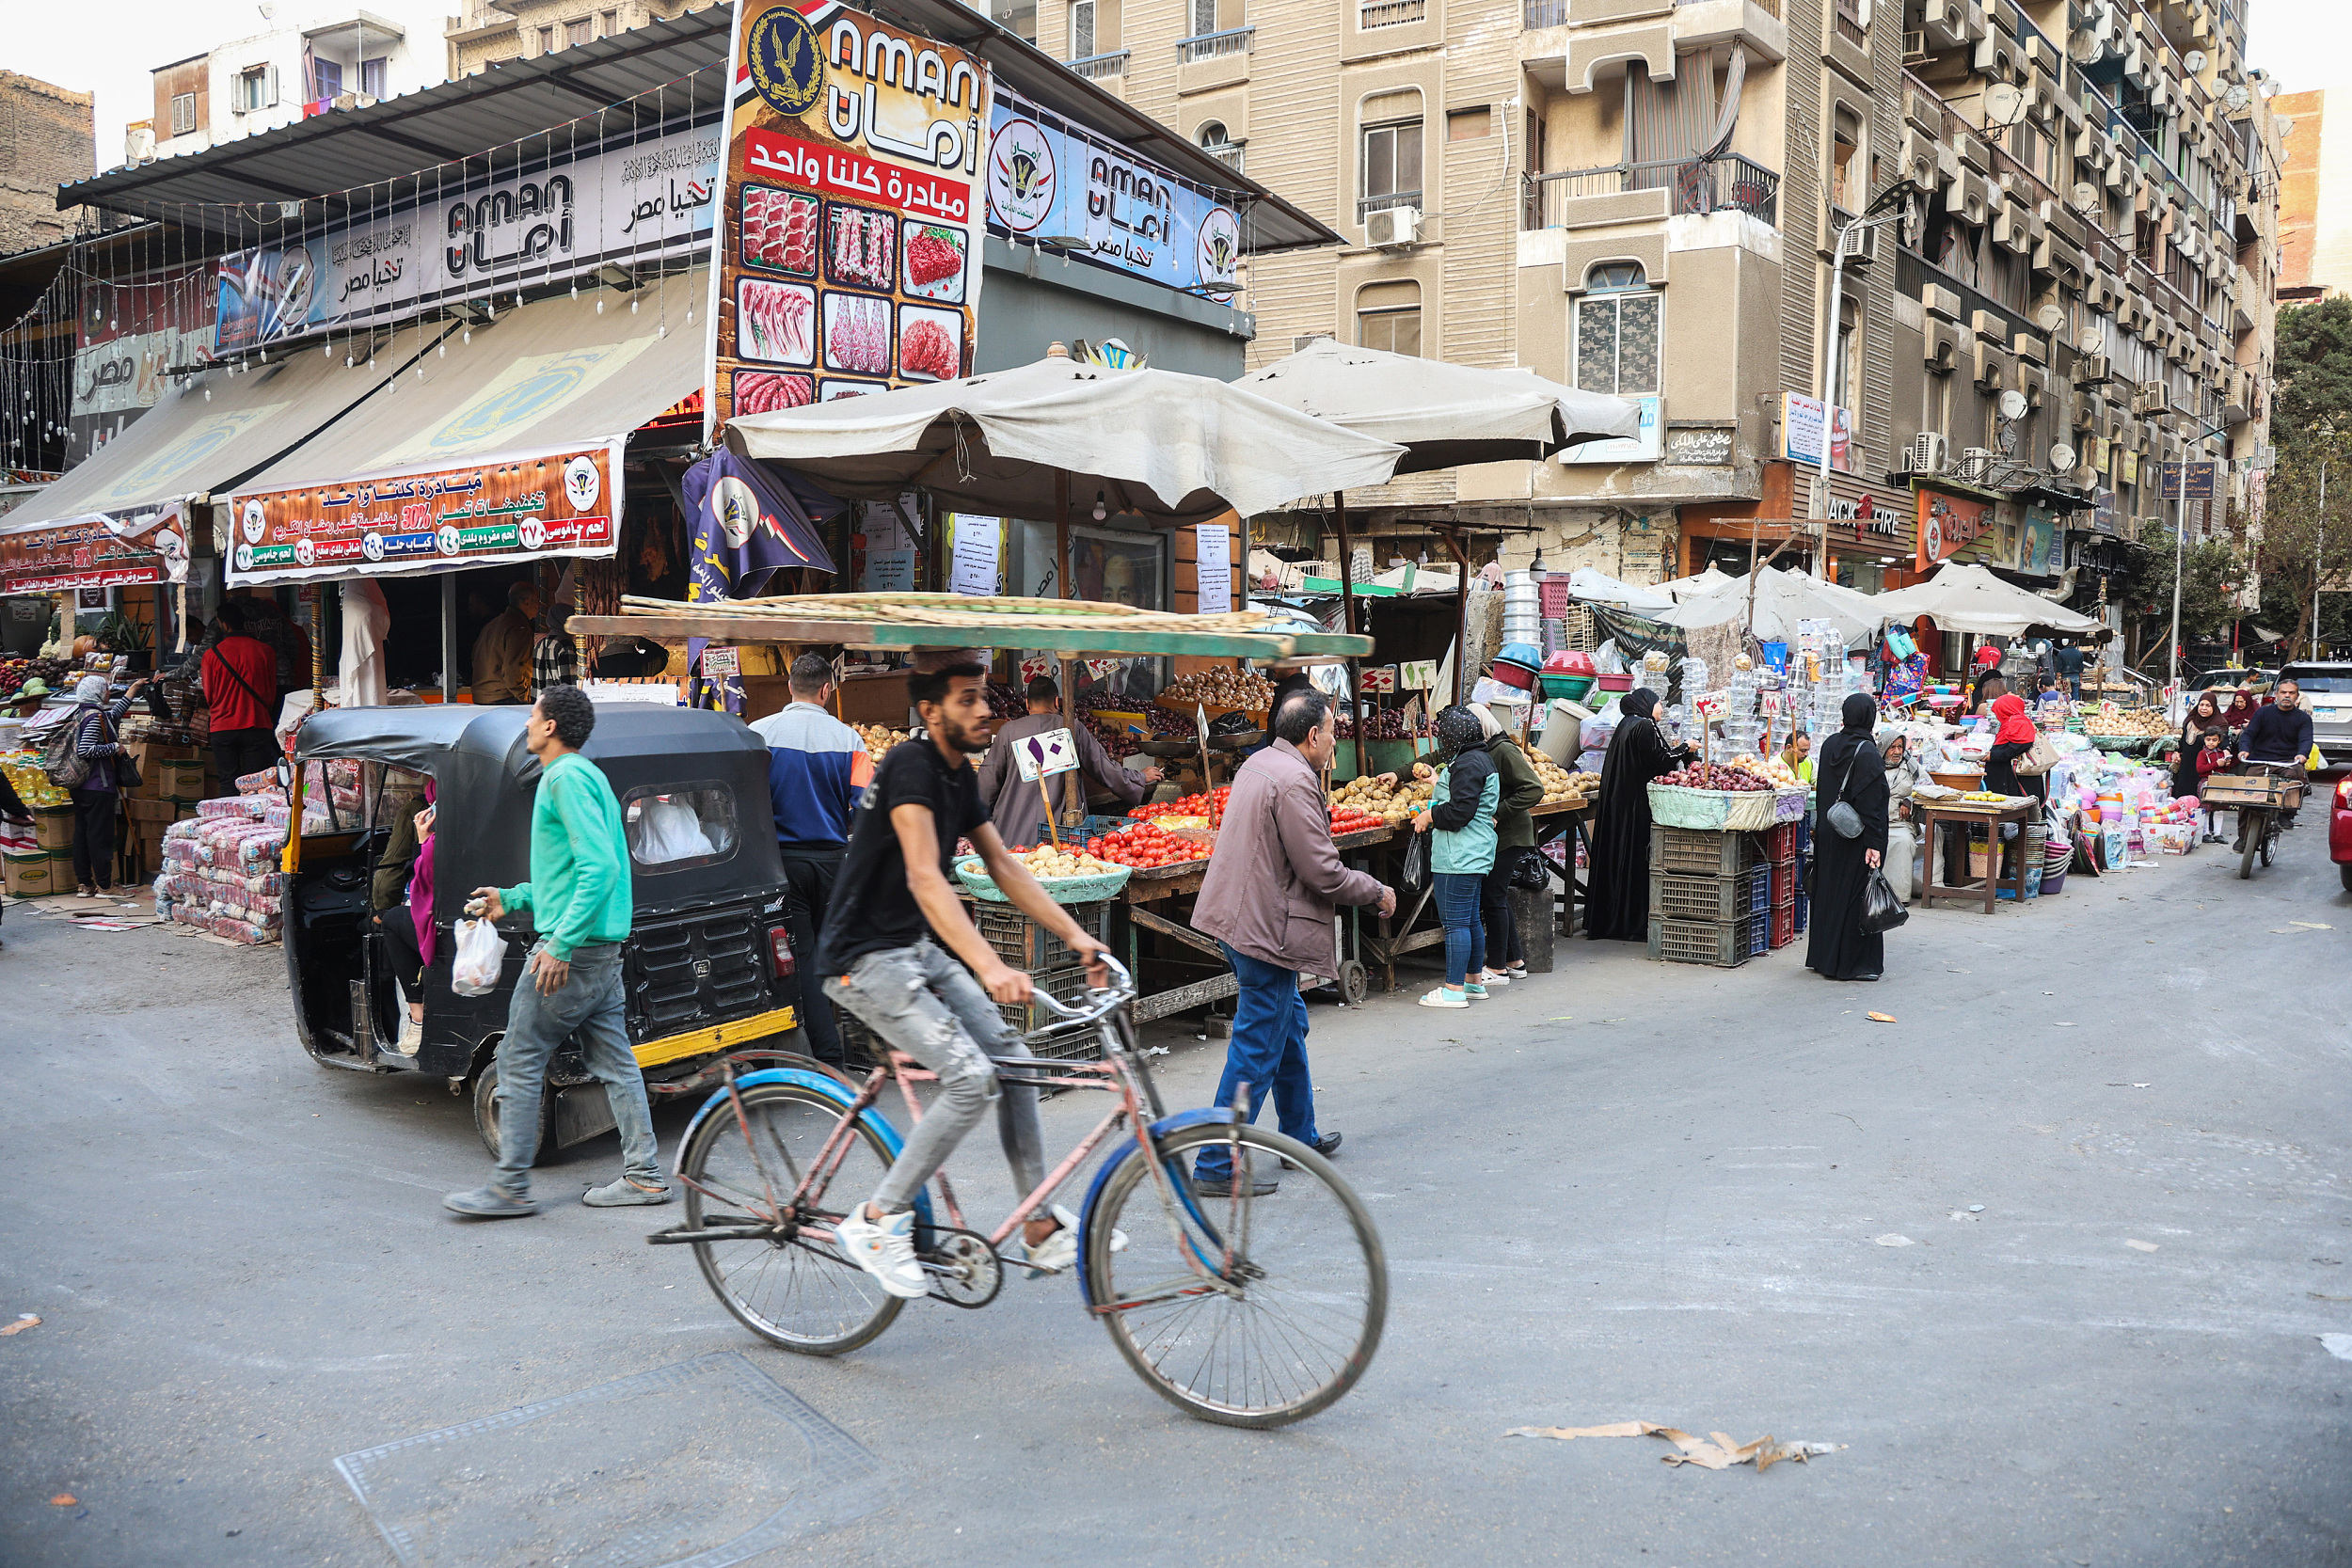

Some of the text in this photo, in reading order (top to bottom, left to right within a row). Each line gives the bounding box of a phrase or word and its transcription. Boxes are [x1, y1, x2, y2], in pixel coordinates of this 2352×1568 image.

[830, 18, 979, 113] AMAN
[828, 82, 978, 176] أمان
[750, 143, 965, 218] مبادرة كلنا واحد
[1091, 157, 1171, 213] AMAN
[448, 175, 573, 238] AMAN
[621, 177, 715, 234] تحيا مصر
[1088, 190, 1170, 246] أمان
[447, 209, 575, 279] أمان
[1090, 238, 1154, 268] تحيا مصر
[373, 258, 403, 293] تحيا
[339, 273, 370, 303] مصر
[77, 356, 135, 405] مصر
[1707, 430, 1731, 448] مصطفى
[2190, 466, 2212, 477] جمال
[322, 476, 483, 508] مبادرة كلنا واحد
[273, 491, 546, 541] تخفيضات تصل 30% بمناسبة شهر رمضان الكريم
[1828, 498, 1857, 528] ACK
[1872, 509, 1901, 535] FIRE
[459, 529, 516, 546] لحم مفروم بلدى
[521, 523, 545, 545] ٢٧٠
[547, 516, 605, 540] لحم جاموسى
[25, 528, 119, 550] بادرة كلنا واحد
[405, 534, 433, 552] كباب
[438, 533, 459, 549] ٢٤٠
[73, 546, 91, 568] 30%
[94, 546, 116, 564] تصل
[237, 549, 253, 564] ٢٧٠
[254, 547, 293, 563] لحم جاموسى
[296, 545, 314, 561] ٣٥٠
[314, 543, 329, 559] صغير
[328, 541, 344, 558] بلدى
[0, 561, 16, 576] الكري
[35, 554, 47, 571] شهر
[47, 553, 72, 569] بمناسبة
[40, 578, 60, 590] المواد
[59, 575, 80, 590] أنواع
[79, 574, 101, 589] جميع
[102, 573, 123, 585] على
[124, 571, 153, 584] عروض
[1035, 570, 1055, 597] مص
[1022, 659, 1046, 684] ٤٠
[1361, 670, 1392, 689] ٤٠
[1696, 698, 1718, 716] ٣٠
[1766, 698, 1777, 711] ١٨
[1027, 736, 1062, 768] ١٠
[697, 965, 708, 974] RE
